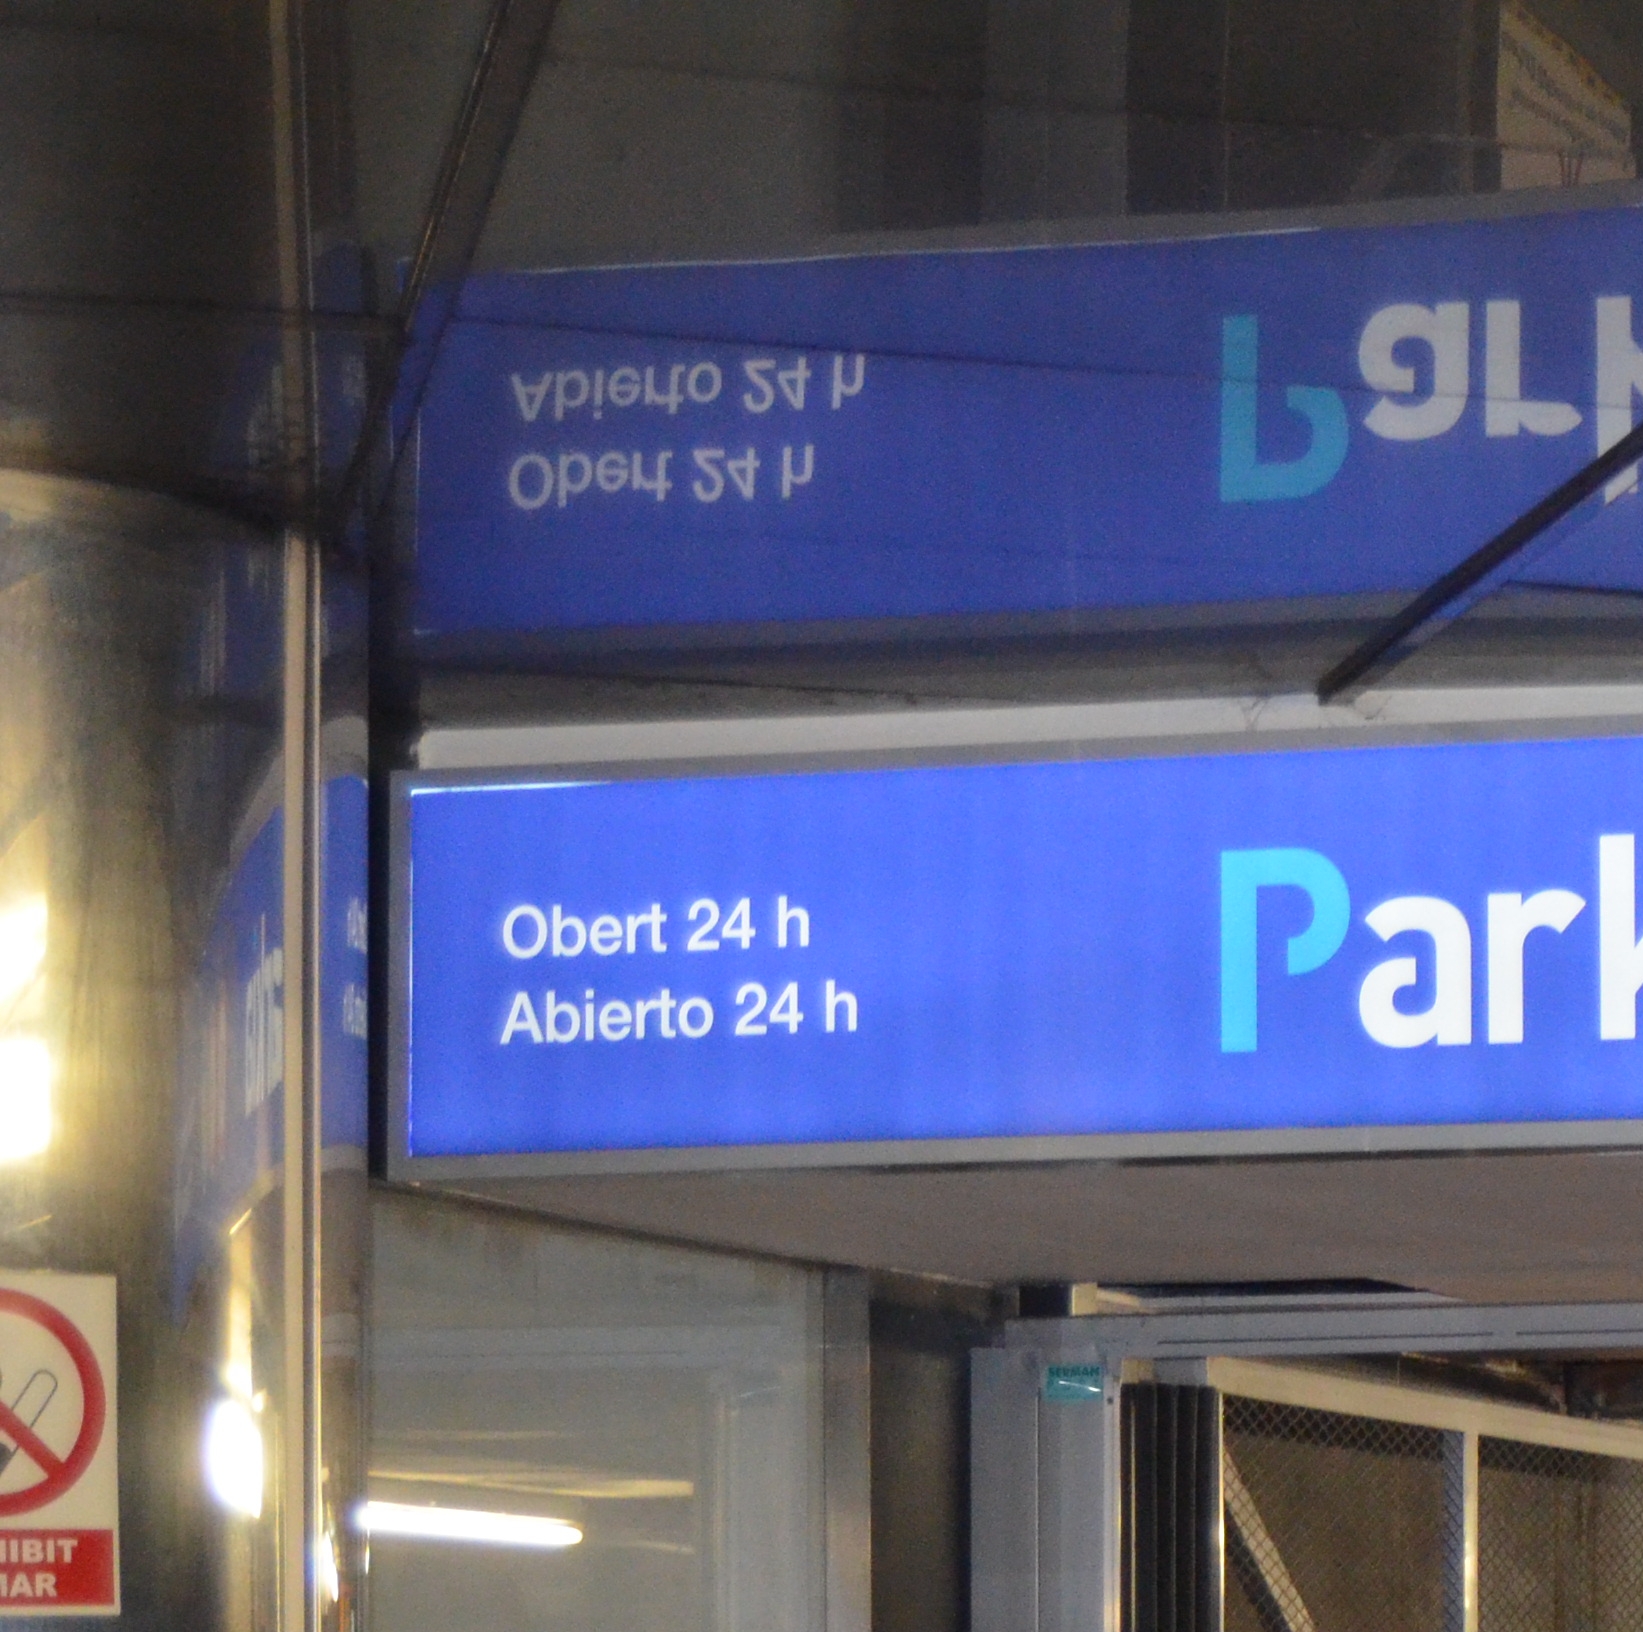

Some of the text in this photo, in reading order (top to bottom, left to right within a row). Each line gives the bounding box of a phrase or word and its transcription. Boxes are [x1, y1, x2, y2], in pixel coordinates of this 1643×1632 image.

[501, 895, 811, 959] Obert 24 h
[500, 979, 859, 1046] Abierto 24 h
[0, 1572, 57, 1598] AR
